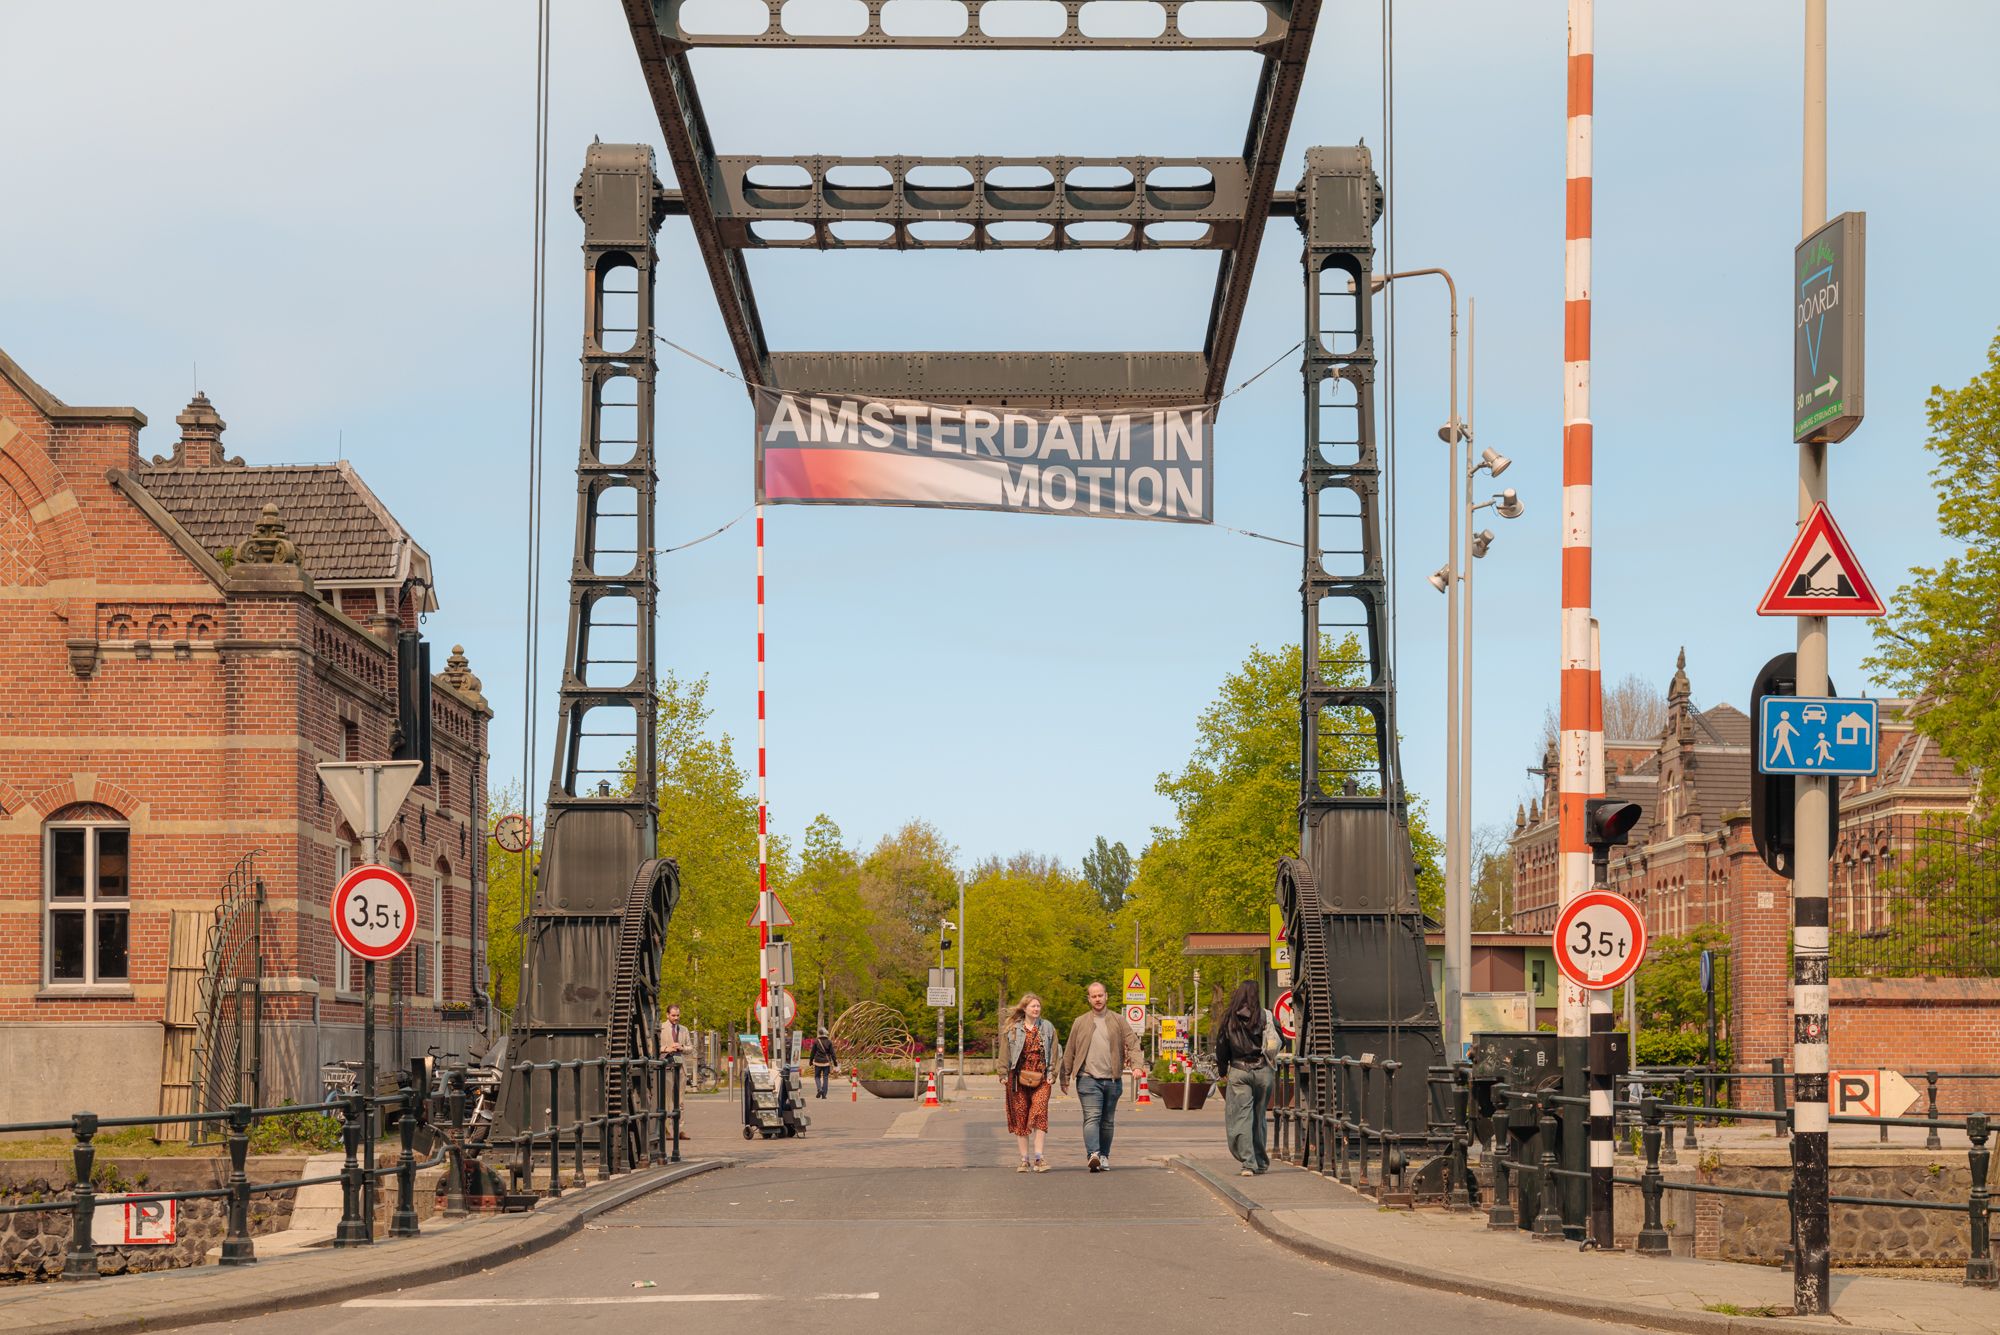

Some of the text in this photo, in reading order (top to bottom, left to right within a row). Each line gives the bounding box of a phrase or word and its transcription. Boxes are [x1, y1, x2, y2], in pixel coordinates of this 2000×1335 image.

[765, 394, 1203, 462] AMSTERDAM IN
[1000, 465, 1203, 518] MOTION
[1839, 1078, 1870, 1112] P
[136, 1200, 165, 1236] P
